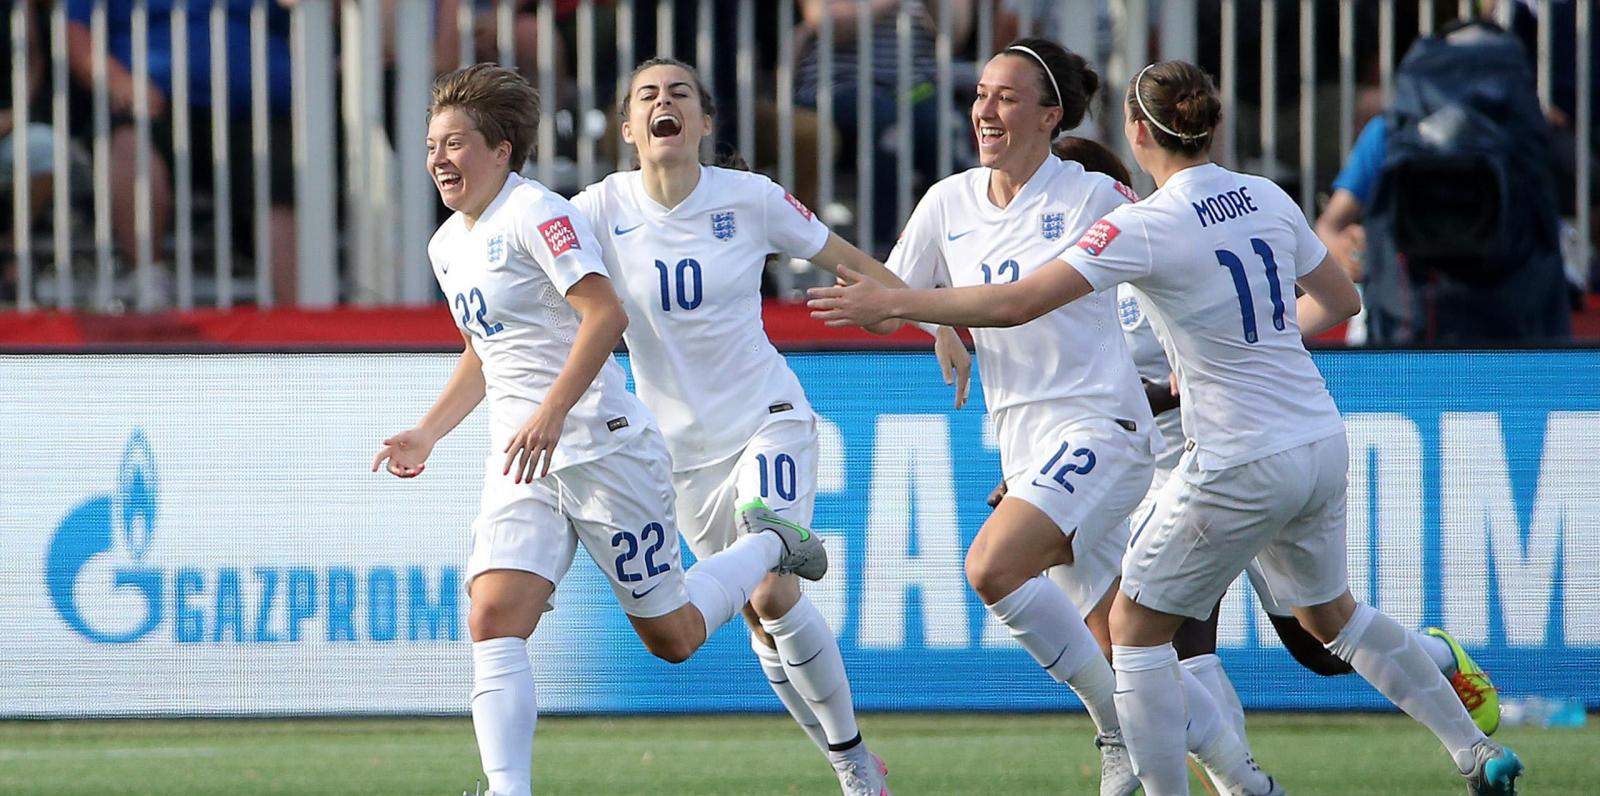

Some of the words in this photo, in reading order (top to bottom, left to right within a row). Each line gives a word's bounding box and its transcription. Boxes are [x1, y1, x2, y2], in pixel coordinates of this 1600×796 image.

[544, 220, 564, 238] LIVE
[1192, 186, 1258, 228] MOORE
[547, 226, 573, 245] YOUR
[552, 232, 576, 252] GOALS
[654, 258, 703, 312] 10
[1215, 238, 1285, 344] 11
[455, 287, 504, 339] 22
[755, 453, 797, 501] 10
[1039, 440, 1098, 495] 12
[611, 521, 671, 583] 22
[174, 566, 459, 643] GAZPROM
